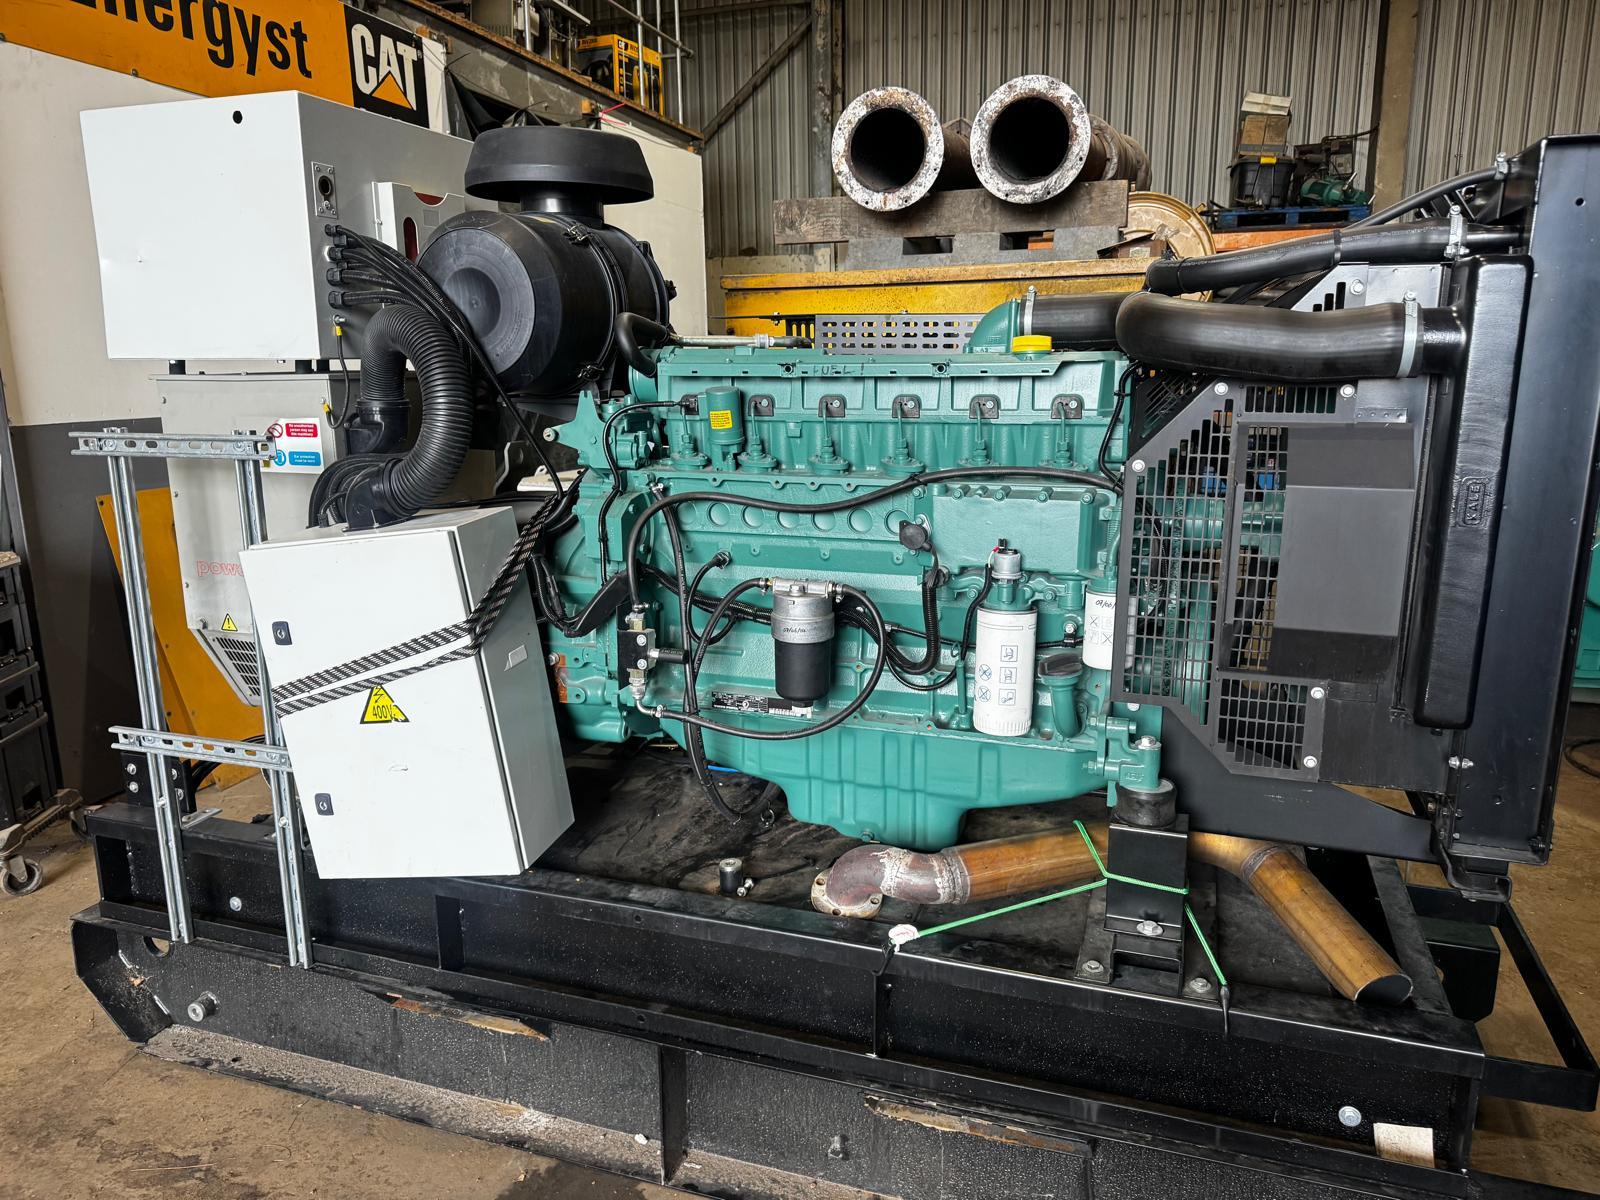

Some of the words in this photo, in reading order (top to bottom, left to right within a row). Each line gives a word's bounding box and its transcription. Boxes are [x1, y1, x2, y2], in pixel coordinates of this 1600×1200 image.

[68, 0, 312, 79] ergyst
[351, 23, 418, 111] CAT
[1466, 486, 1480, 521] KALE
